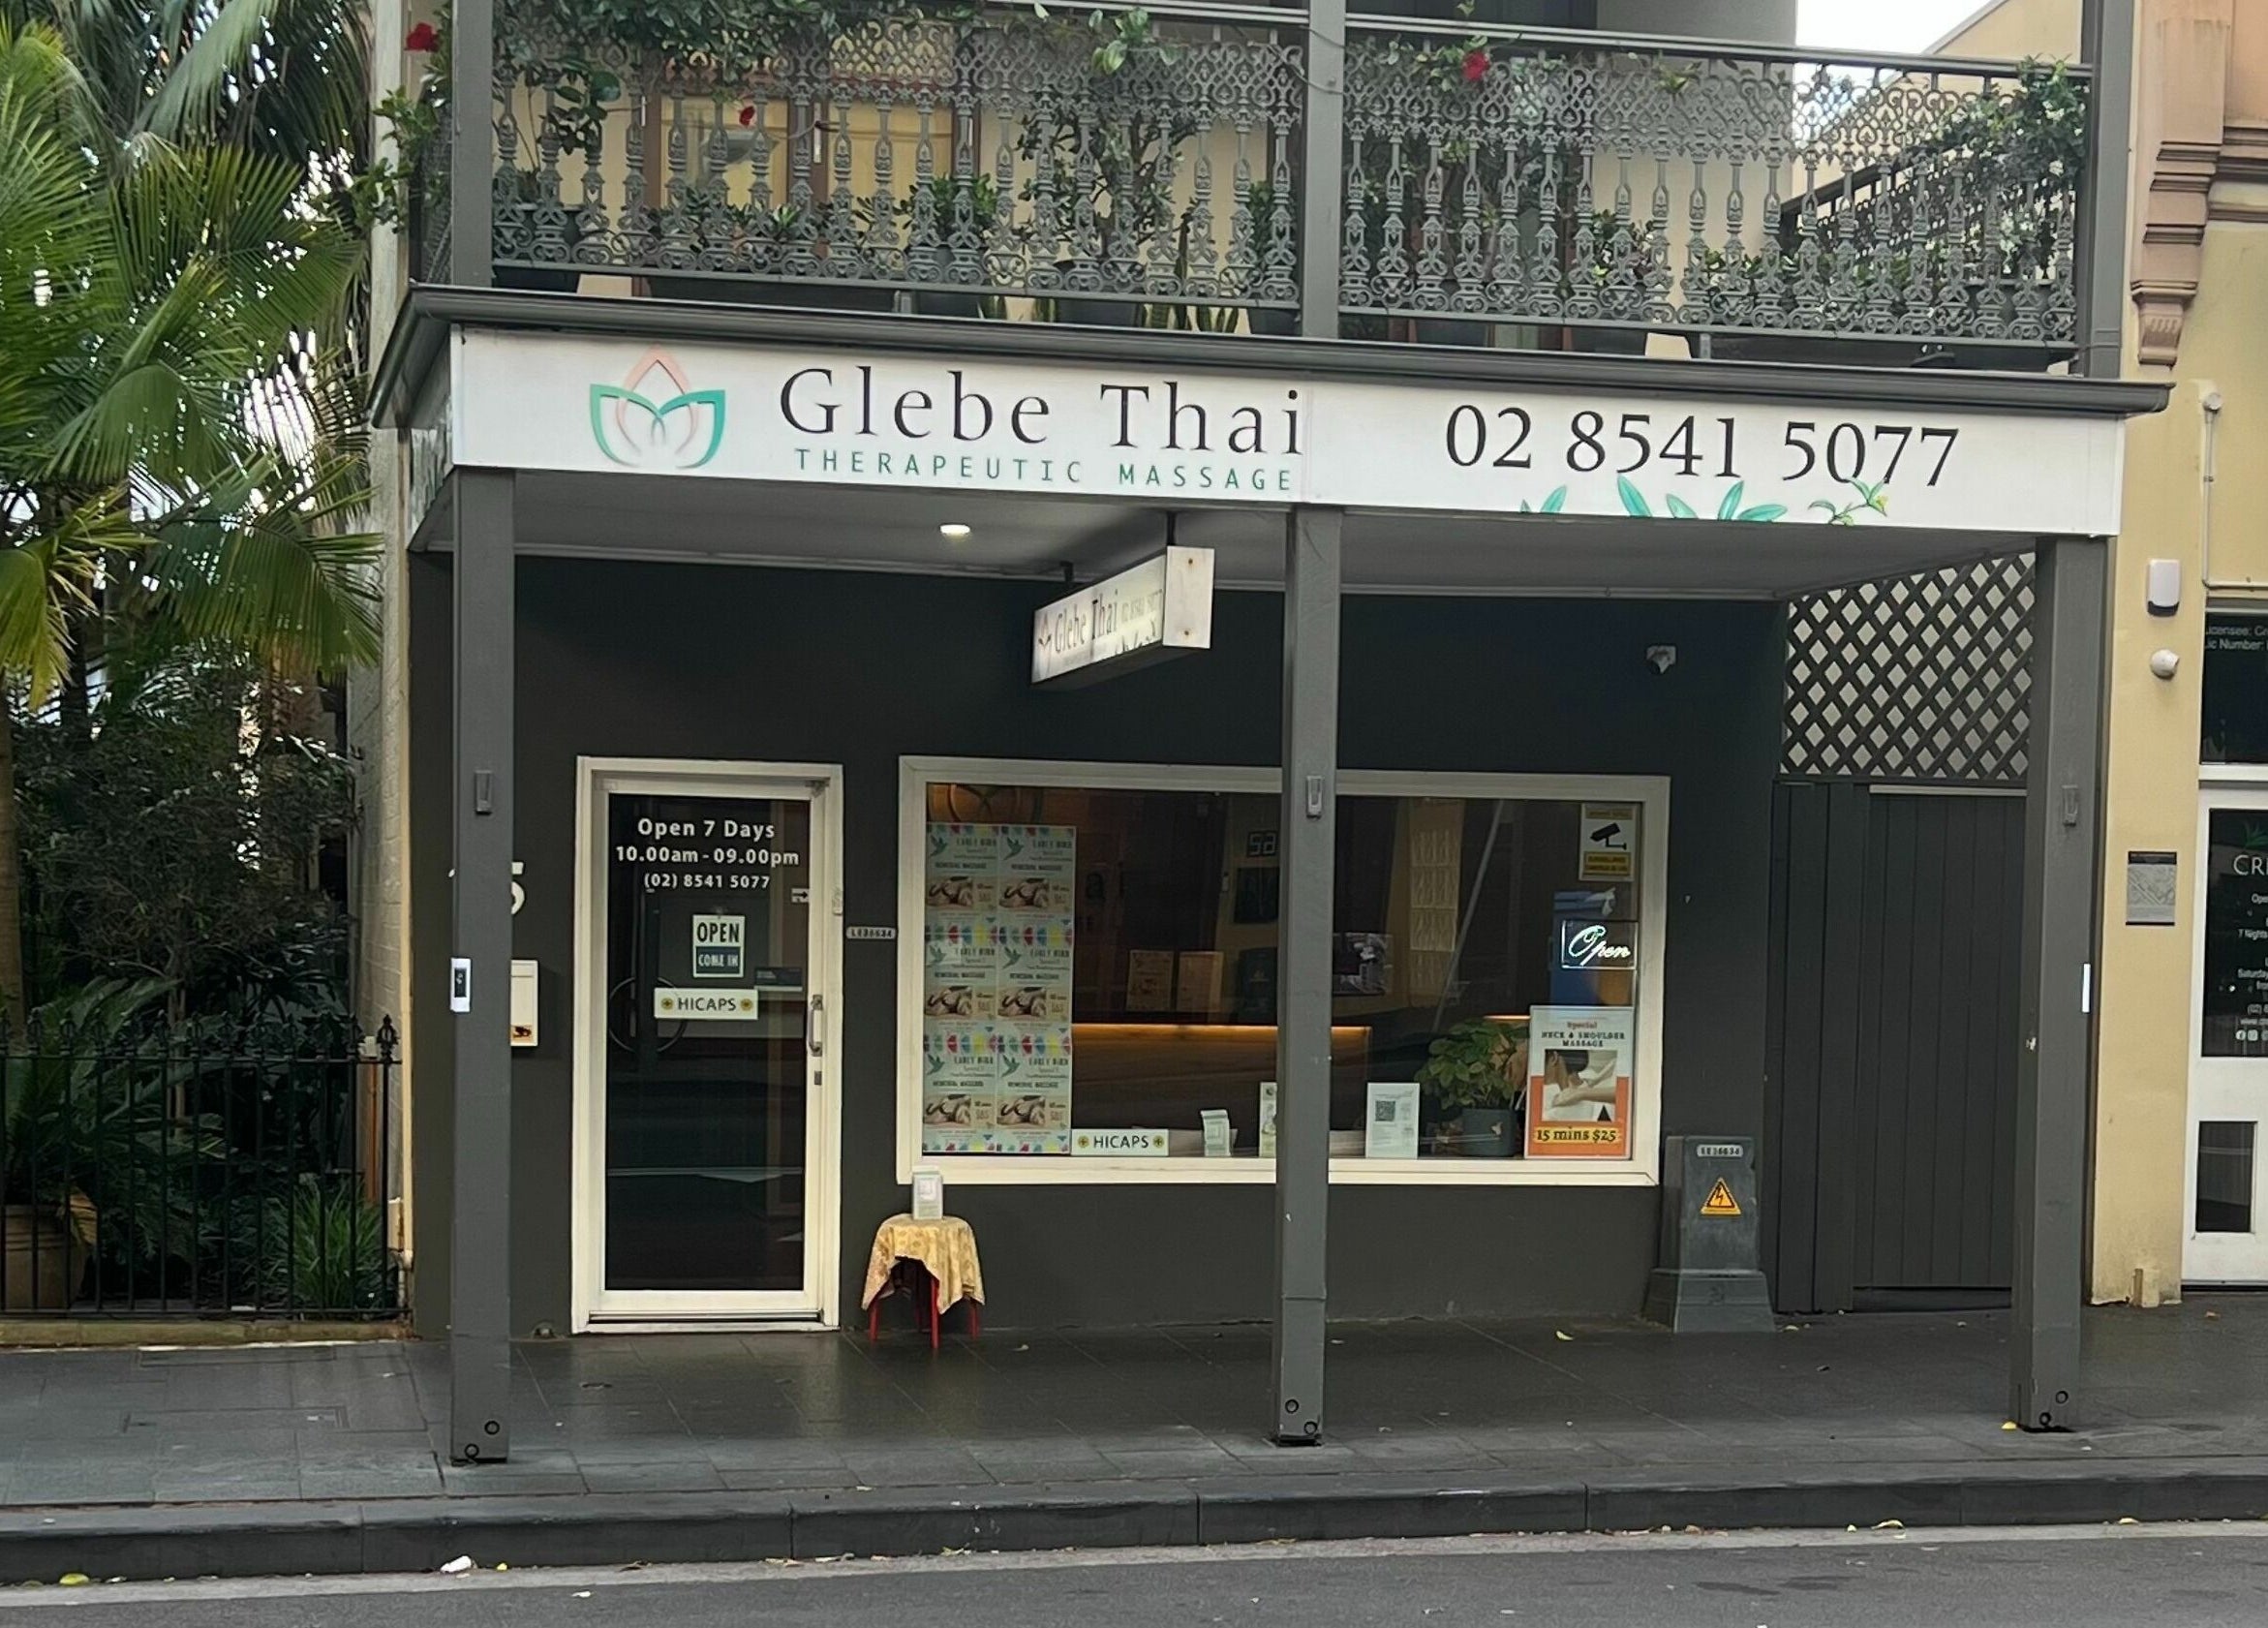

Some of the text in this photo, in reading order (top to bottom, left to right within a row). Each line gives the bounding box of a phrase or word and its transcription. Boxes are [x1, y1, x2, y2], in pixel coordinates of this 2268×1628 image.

[780, 366, 1303, 456] Glebe Thai
[1446, 405, 1960, 487] 02 8541 5077
[795, 447, 1291, 492] THERAPEUTIC MASSAGE
[1091, 588, 1118, 641] Thai
[637, 818, 776, 842] Open 7 Days
[616, 845, 699, 864] 10.00am
[713, 848, 800, 868] 09.00pm
[2233, 854, 2268, 876] CR
[644, 874, 770, 889] (02) 8541 5077
[696, 922, 740, 943] OPEN
[1568, 925, 1631, 968] Open
[698, 954, 739, 968] COME IN
[677, 998, 737, 1012] HICAPS
[1567, 1021, 1598, 1029] Special
[1578, 1031, 1626, 1040] SHOULDER
[1093, 1135, 1149, 1149] HICAPS
[1537, 1125, 1617, 1144] 15 mins $25
